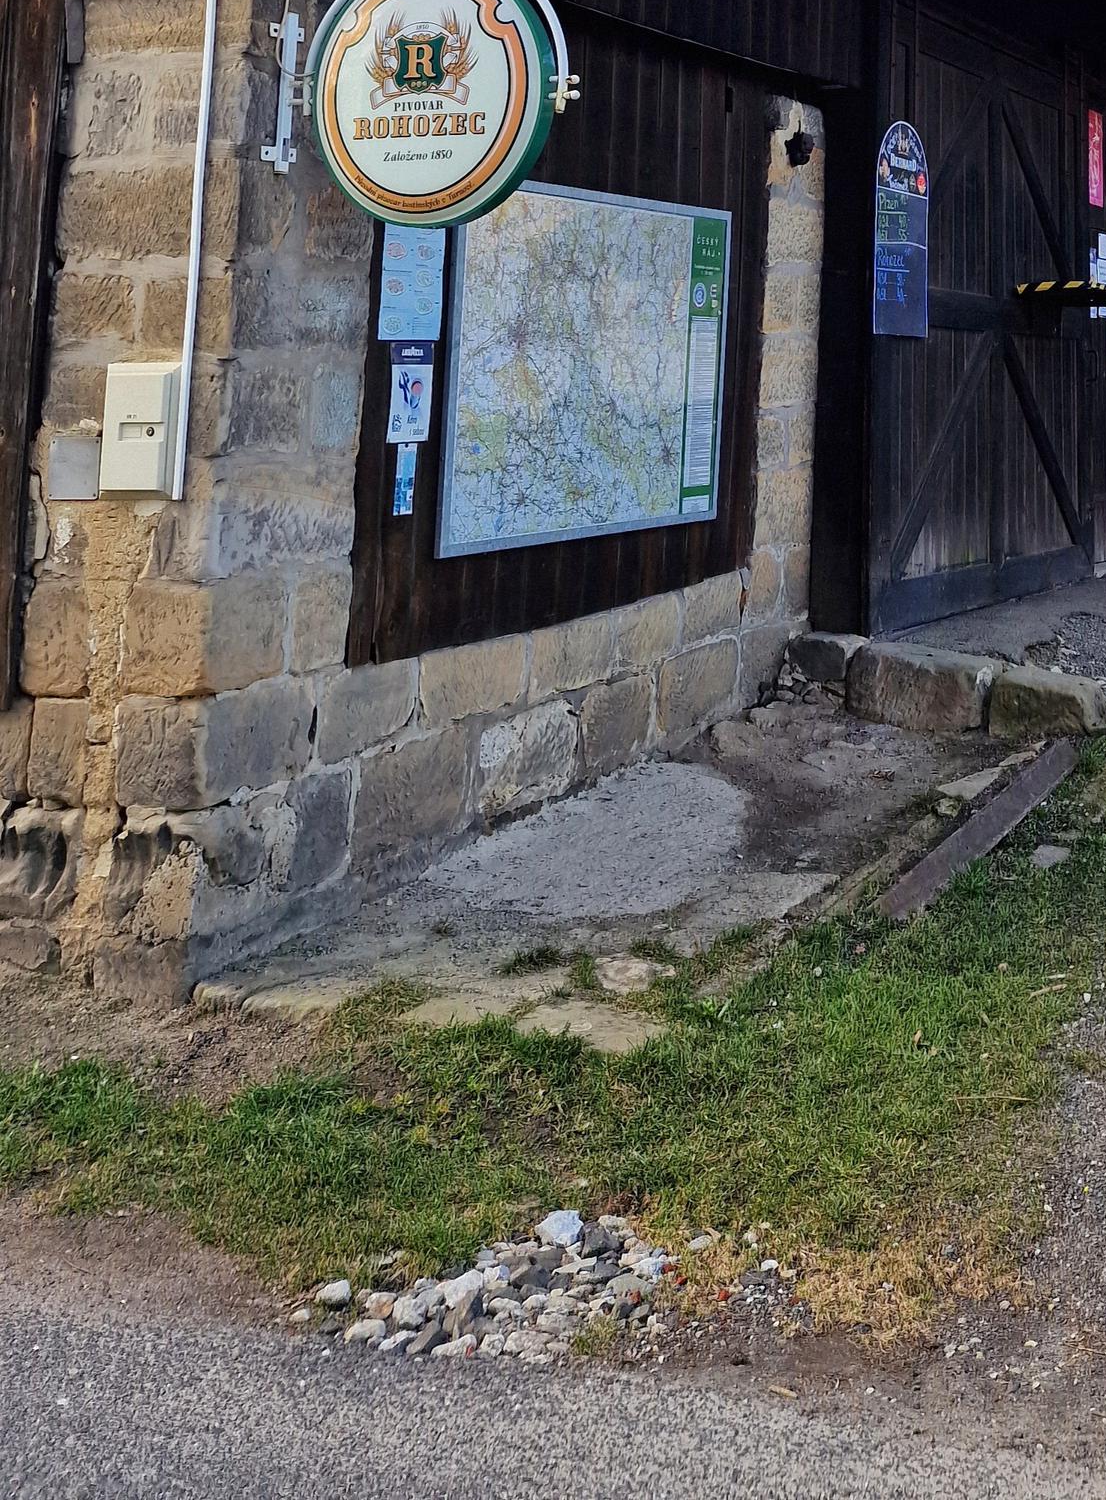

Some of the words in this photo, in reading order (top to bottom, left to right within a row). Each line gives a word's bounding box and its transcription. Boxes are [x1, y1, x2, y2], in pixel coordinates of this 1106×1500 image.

[403, 44, 437, 79] R
[393, 100, 444, 112] PIVOVAR
[353, 112, 486, 140] ROHOZEC
[383, 150, 428, 162] Založeno
[430, 149, 453, 160] 1850
